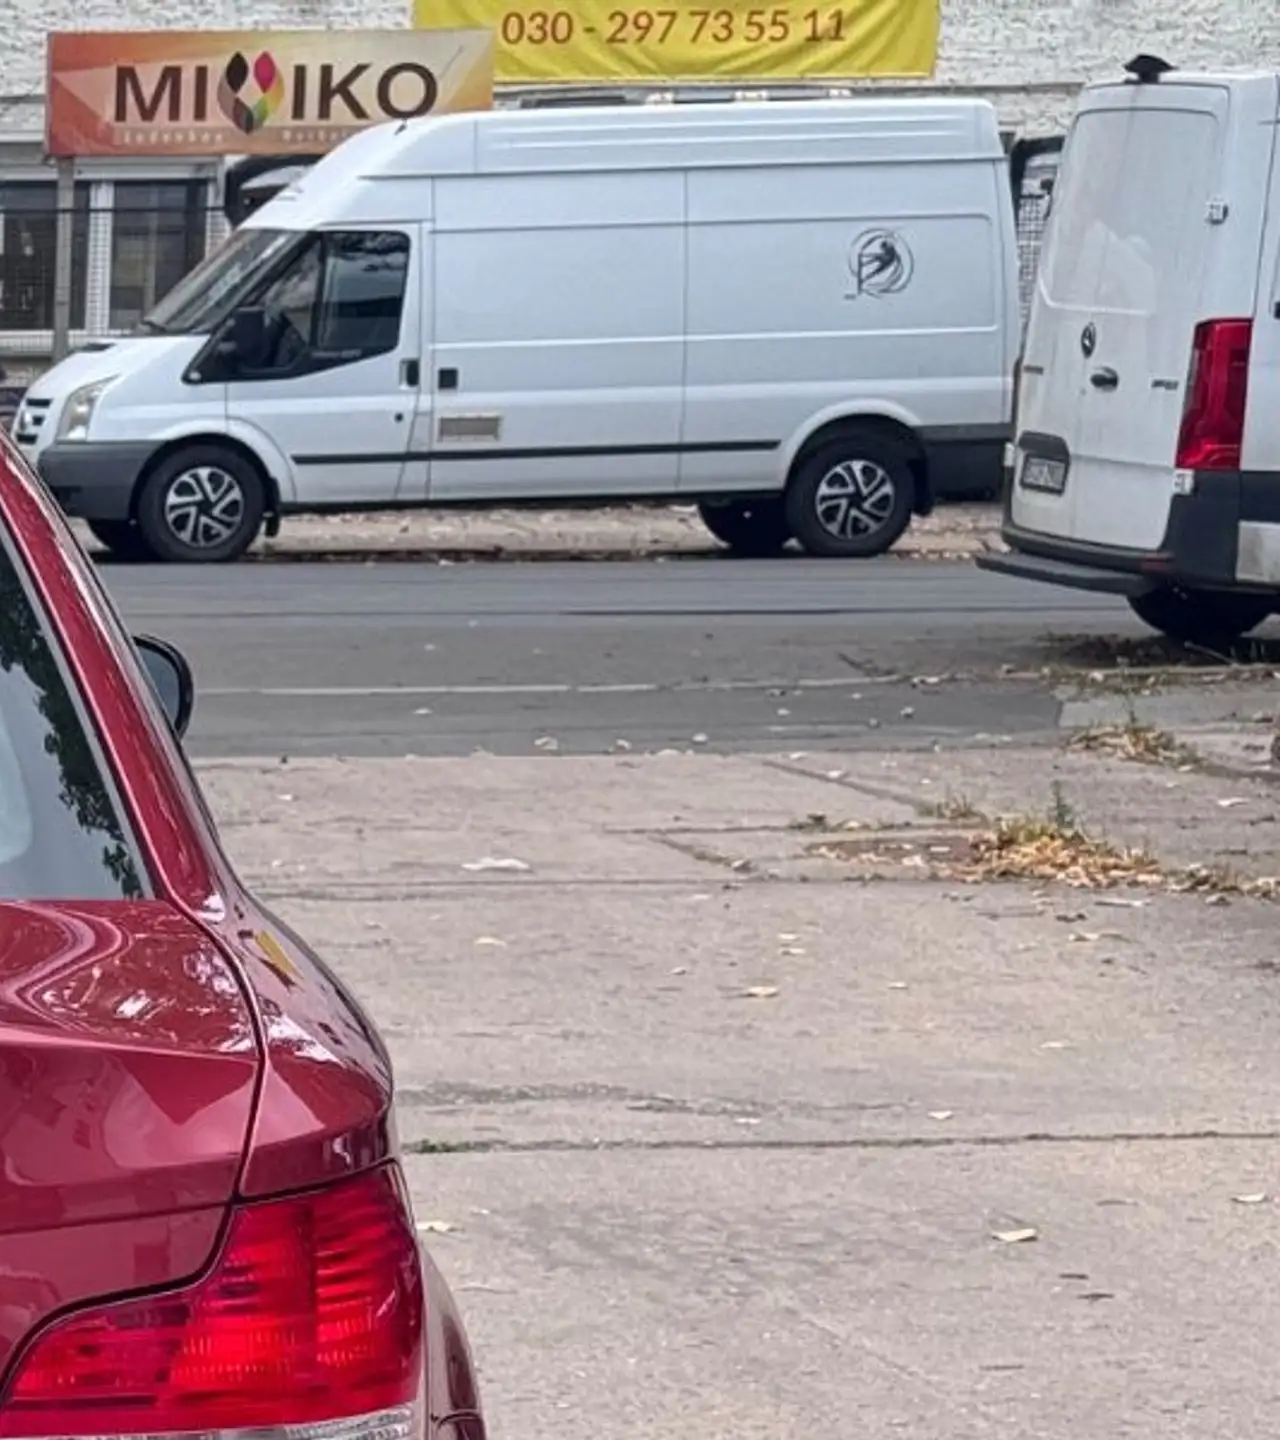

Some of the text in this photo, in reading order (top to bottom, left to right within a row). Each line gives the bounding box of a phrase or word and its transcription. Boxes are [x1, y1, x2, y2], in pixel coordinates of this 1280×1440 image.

[501, 11, 574, 45] 030
[605, 10, 678, 44] 297
[688, 9, 734, 44] 73
[743, 9, 790, 43] 55
[802, 9, 846, 43] 11
